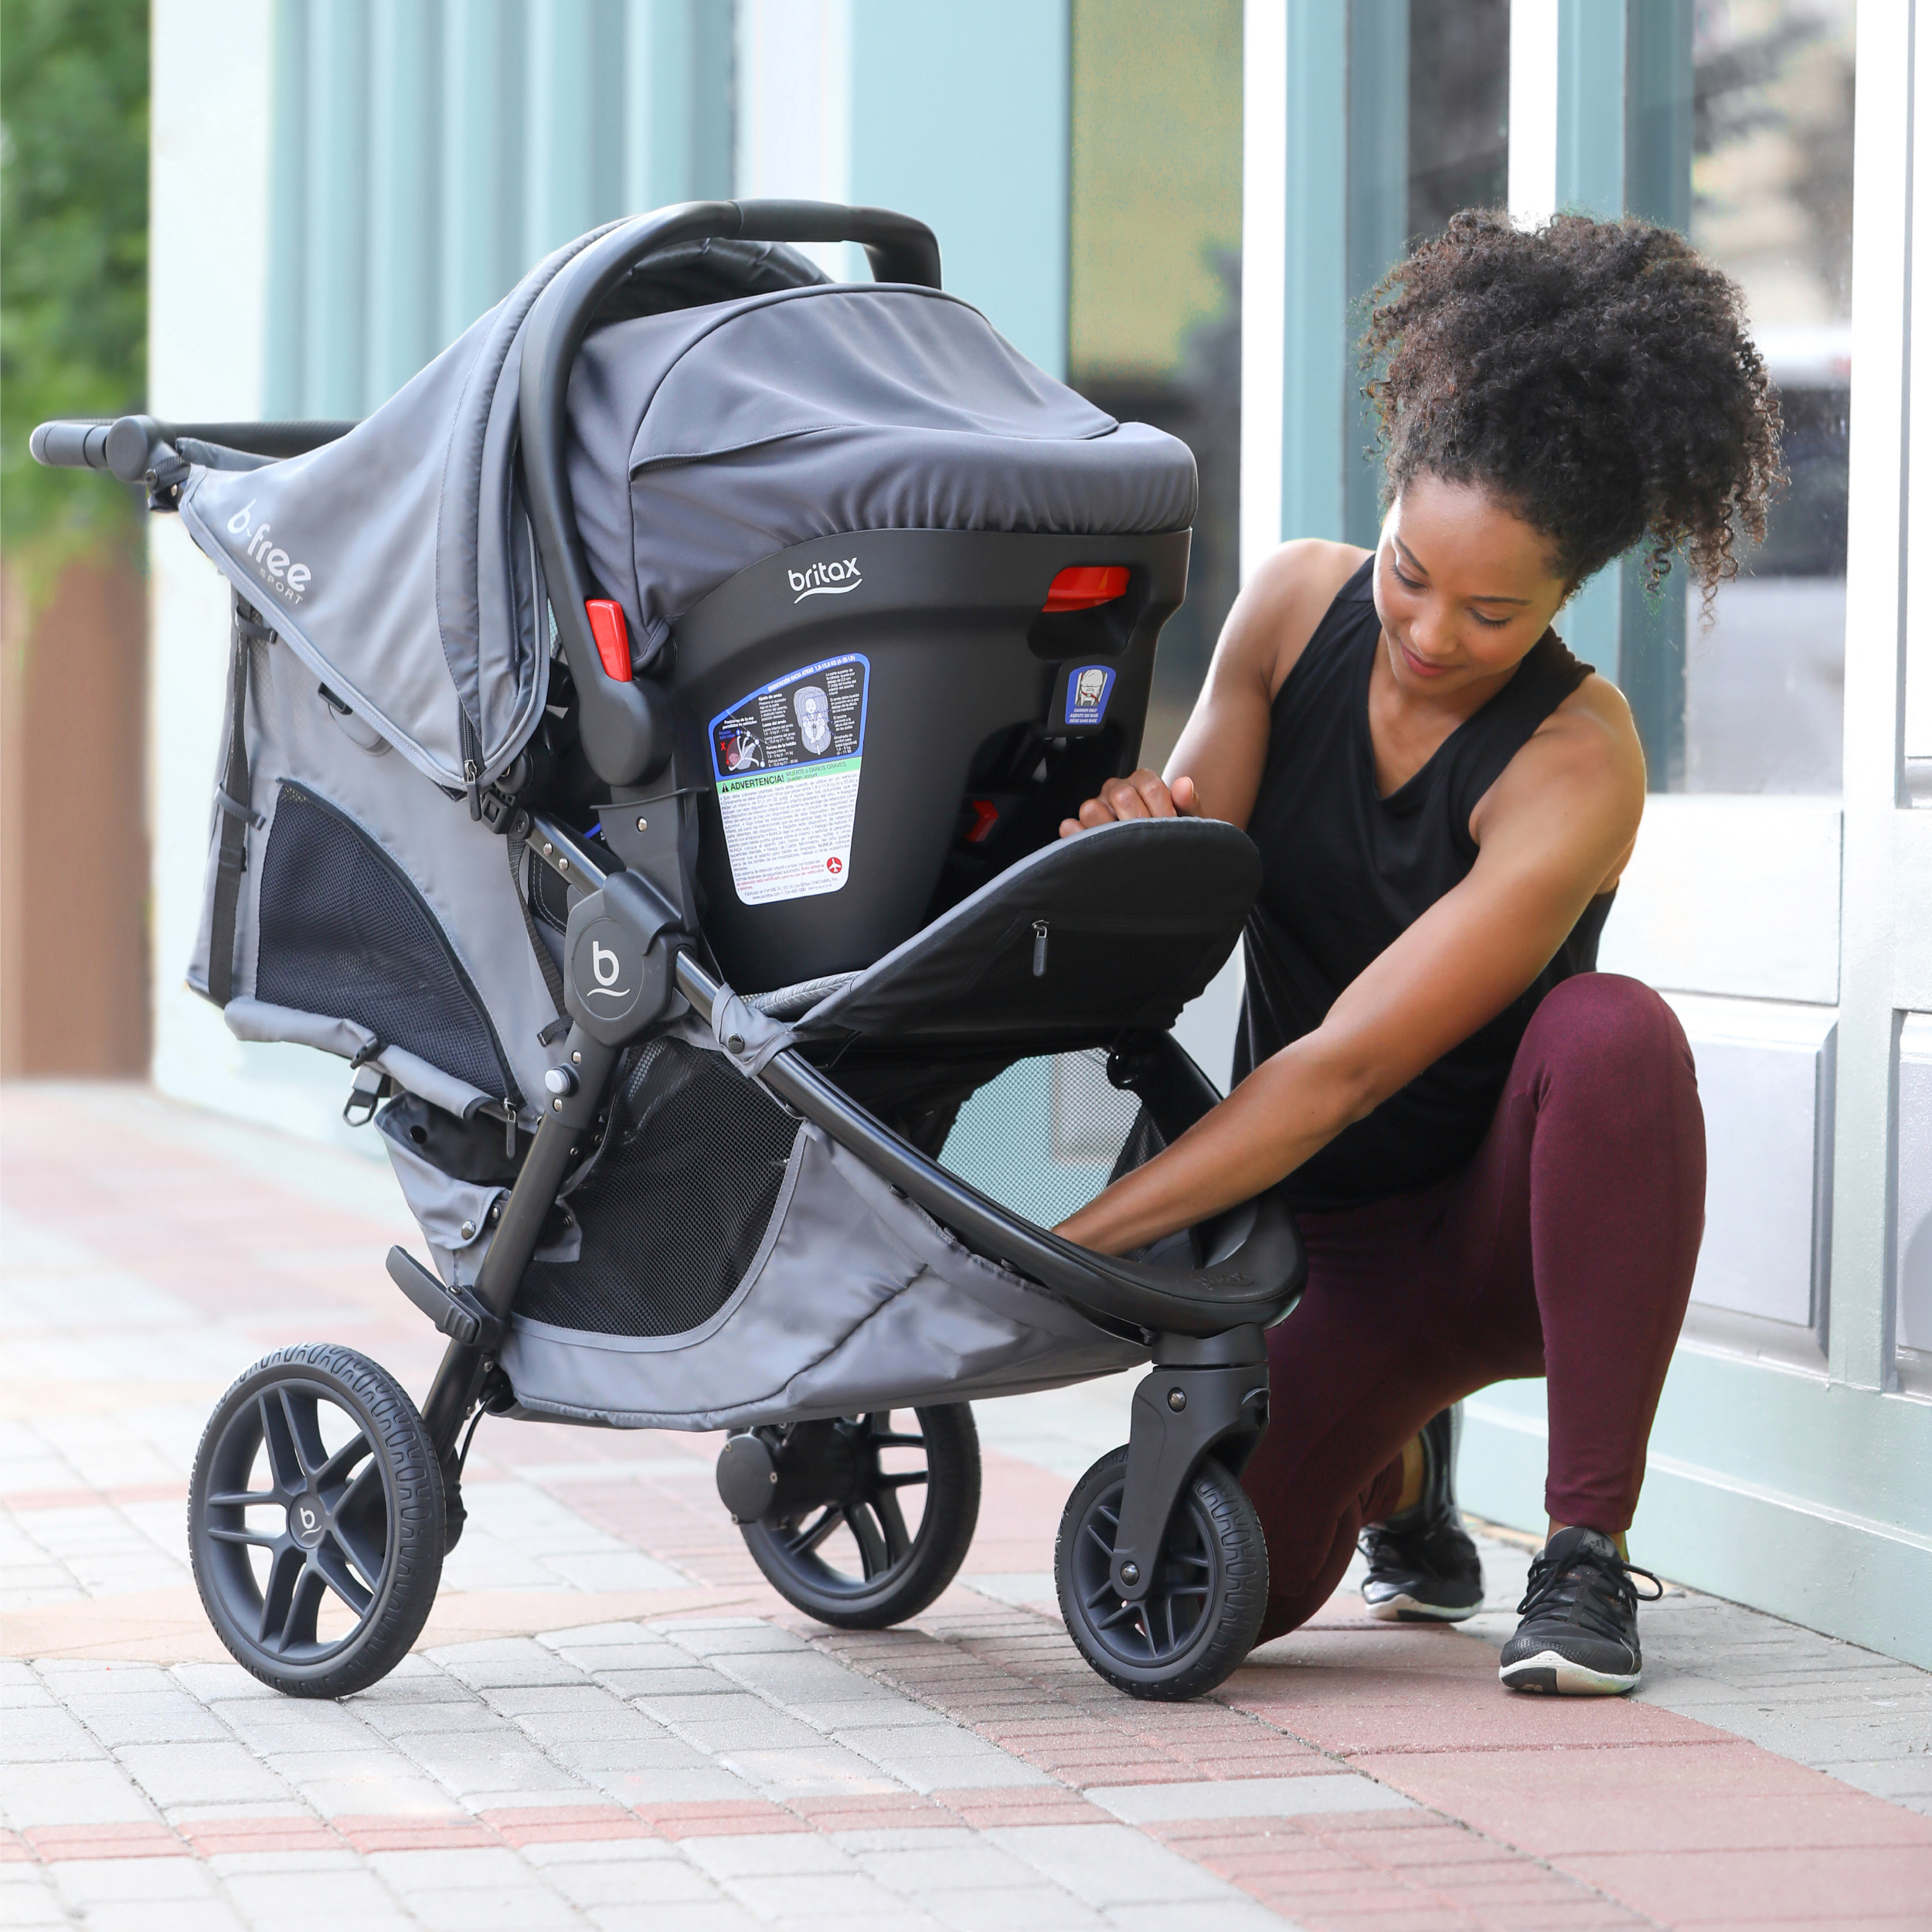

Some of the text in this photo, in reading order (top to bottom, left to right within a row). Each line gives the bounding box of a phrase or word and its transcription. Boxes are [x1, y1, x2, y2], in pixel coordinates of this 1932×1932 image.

[260, 568, 304, 604] SPORT
[787, 556, 862, 592] britax
[730, 774, 784, 791] ADVERTENCIA!
[786, 768, 805, 777] MUERTE
[809, 765, 826, 774] DAÑOS
[827, 761, 846, 770] GRAVES
[592, 941, 619, 986] b
[300, 1507, 315, 1529] b
